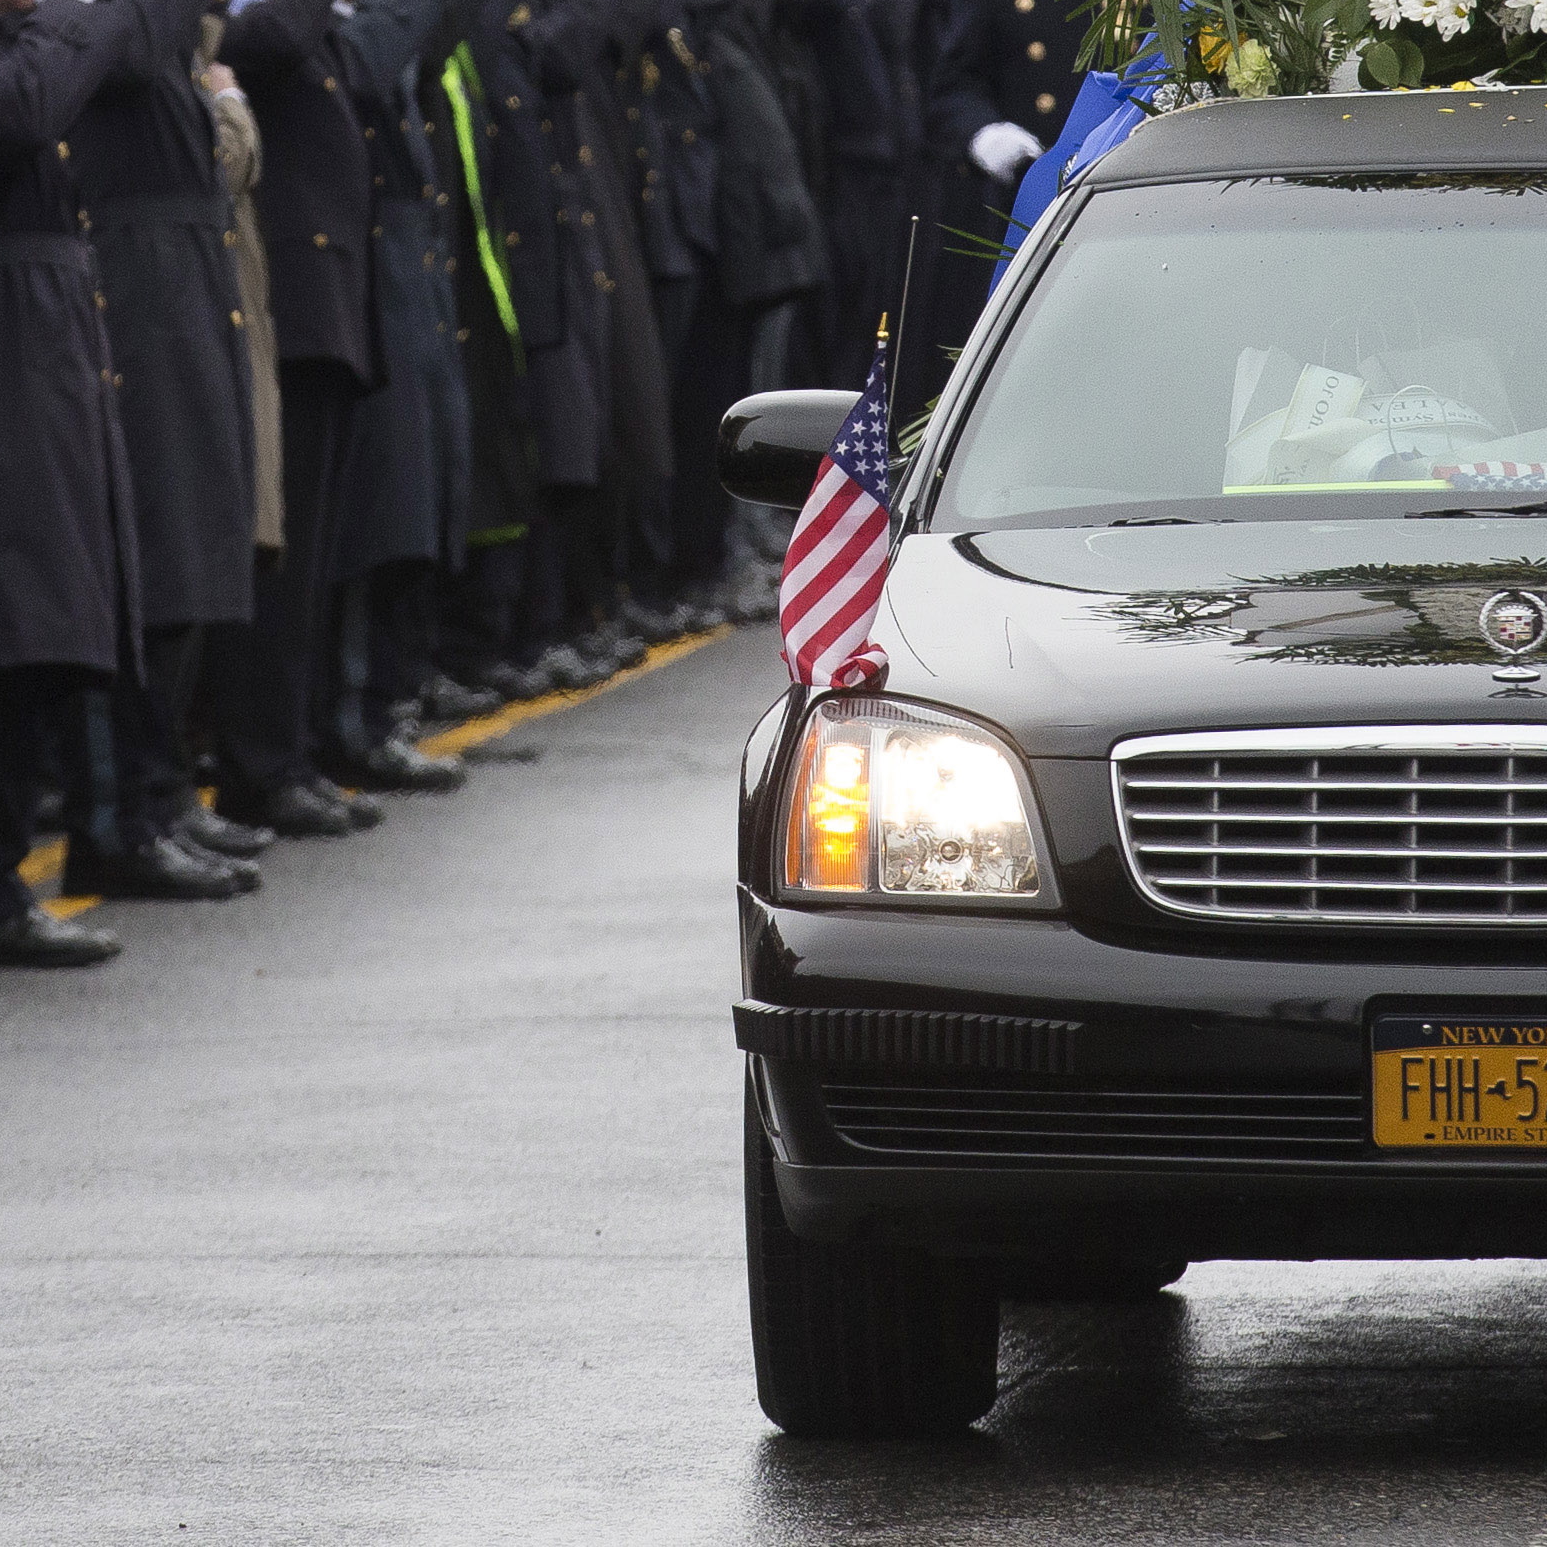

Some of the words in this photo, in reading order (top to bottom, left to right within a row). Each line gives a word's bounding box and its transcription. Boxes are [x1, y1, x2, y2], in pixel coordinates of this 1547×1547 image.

[1441, 1026, 1505, 1045] NEW
[1401, 1055, 1480, 1122] FHH
[1443, 1125, 1514, 1142] EMPIRE
